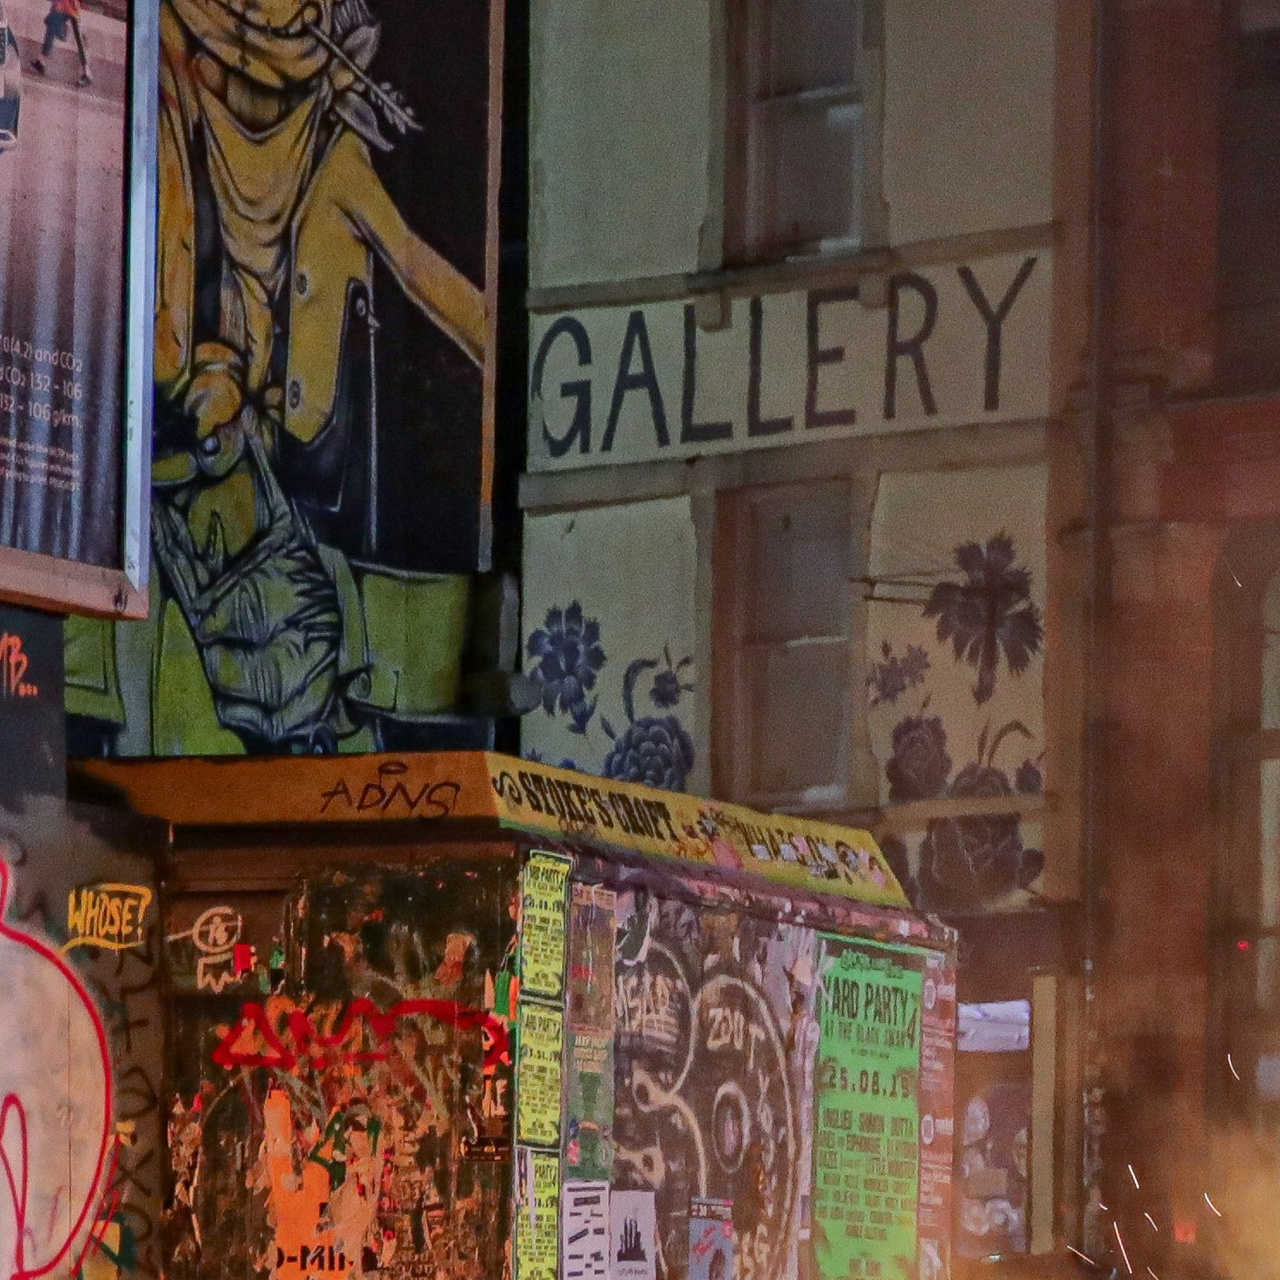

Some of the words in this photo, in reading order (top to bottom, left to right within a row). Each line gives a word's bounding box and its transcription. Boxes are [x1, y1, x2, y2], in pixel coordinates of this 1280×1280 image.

[34, 347, 59, 366] and
[531, 257, 1037, 458] GALLERY
[864, 982, 908, 1027] PARTY
